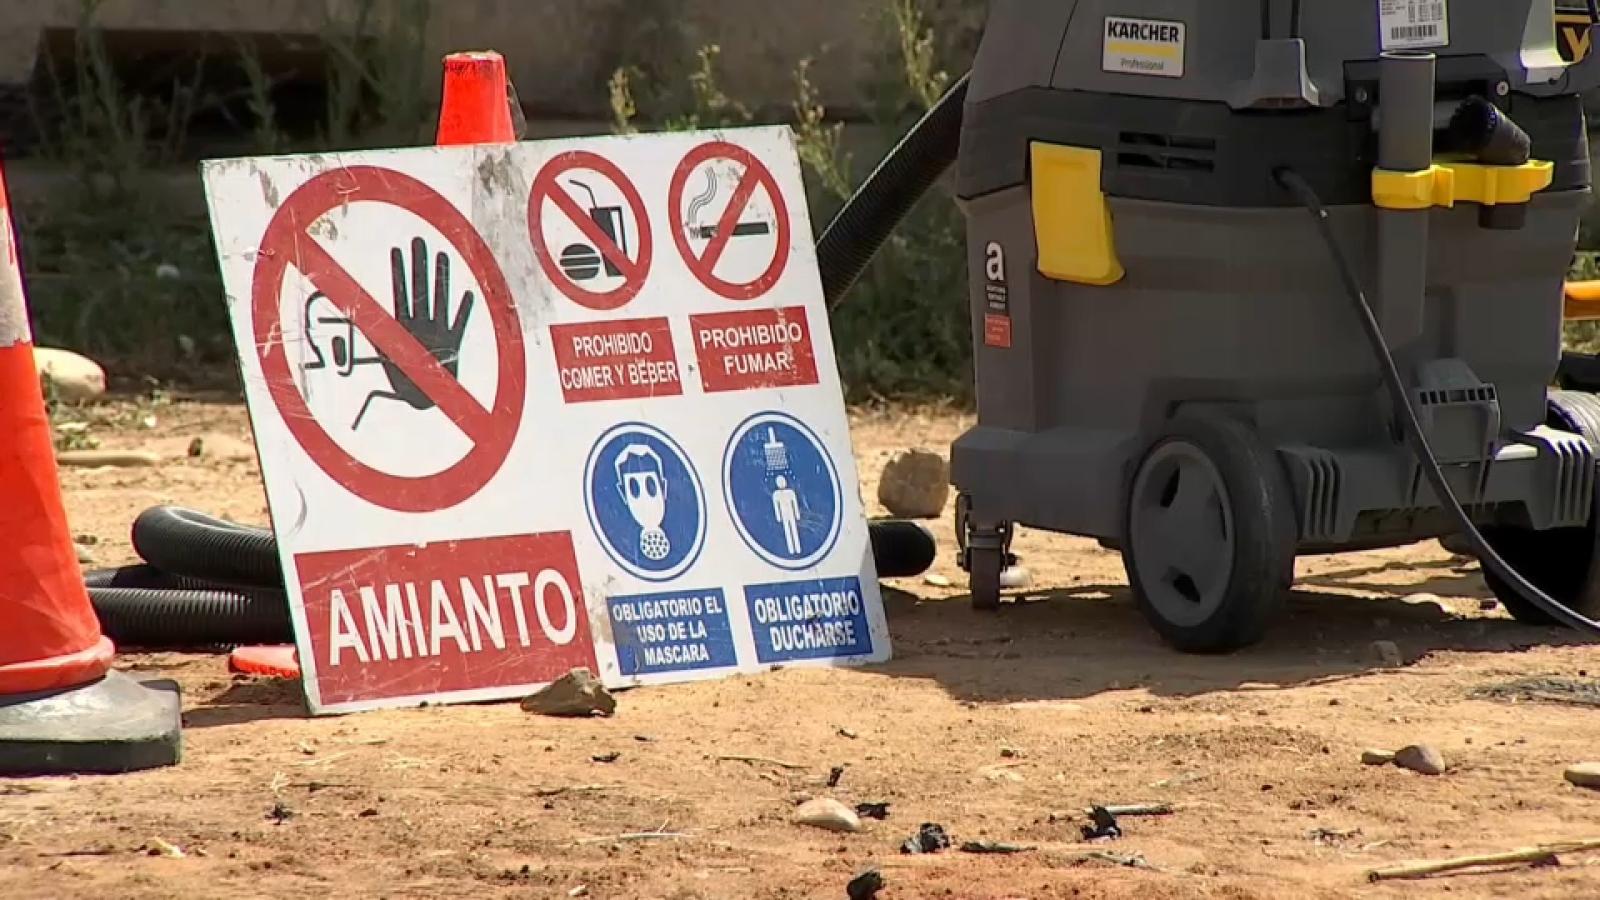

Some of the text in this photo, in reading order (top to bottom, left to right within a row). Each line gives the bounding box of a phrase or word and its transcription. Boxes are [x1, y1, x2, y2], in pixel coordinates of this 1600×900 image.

[986, 241, 1005, 281] a
[572, 331, 653, 358] PROHIBIDO
[700, 321, 802, 349] PROHIBIDO
[560, 360, 677, 390] COMER Y BEBER
[723, 351, 791, 375] FUMAR
[329, 568, 577, 666] AMIANTO
[612, 595, 723, 622] OBLIGATORIO EL
[754, 589, 860, 624] OBLIGATORIO
[636, 619, 708, 642] USO DE LA
[769, 620, 857, 652] DUCHARSE
[644, 642, 711, 666] MASCARA
